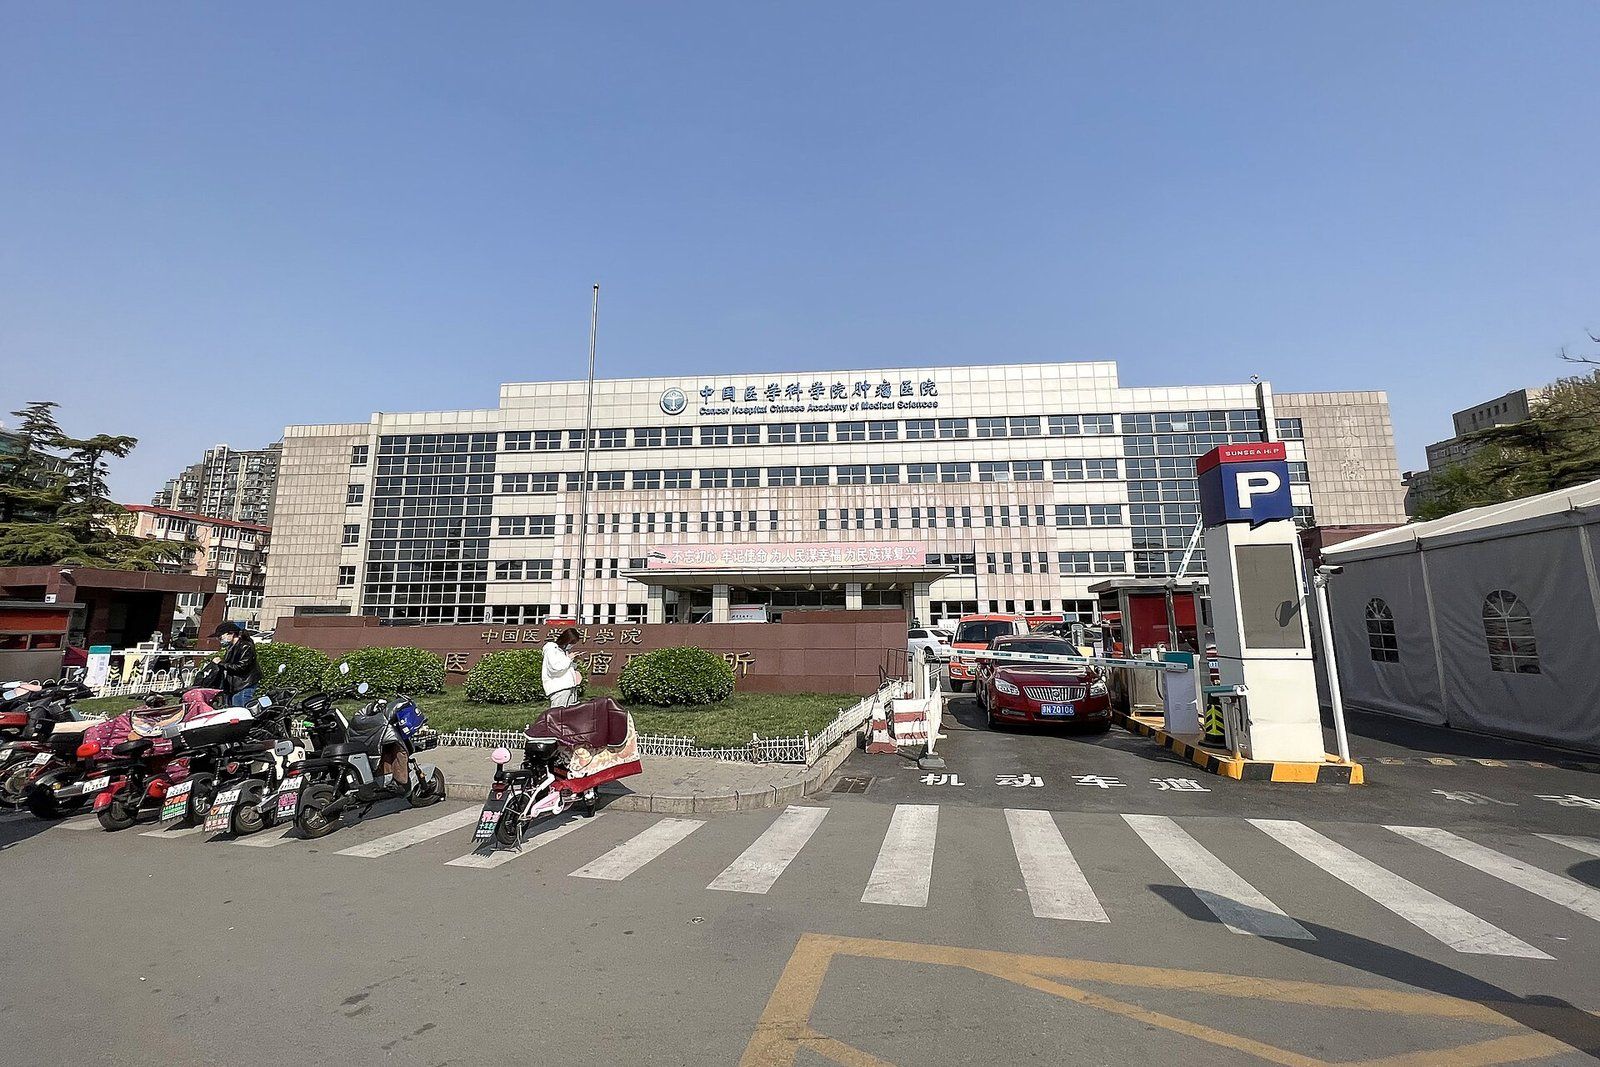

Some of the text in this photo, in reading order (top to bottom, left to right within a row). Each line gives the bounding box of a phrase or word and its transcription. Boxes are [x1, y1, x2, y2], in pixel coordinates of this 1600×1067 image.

[699, 378, 939, 405] 中国医学科学院肿瘤医院
[699, 400, 939, 416] Cancer Hospital Chinese Academy of Medical Sciences
[1225, 449, 1262, 457] SUNSEA
[1236, 471, 1281, 509] P
[671, 546, 917, 564] 不忘初心 牢记使命 为人民谋幸福 为民族谋复兴
[919, 773, 1212, 792] 机动车道
